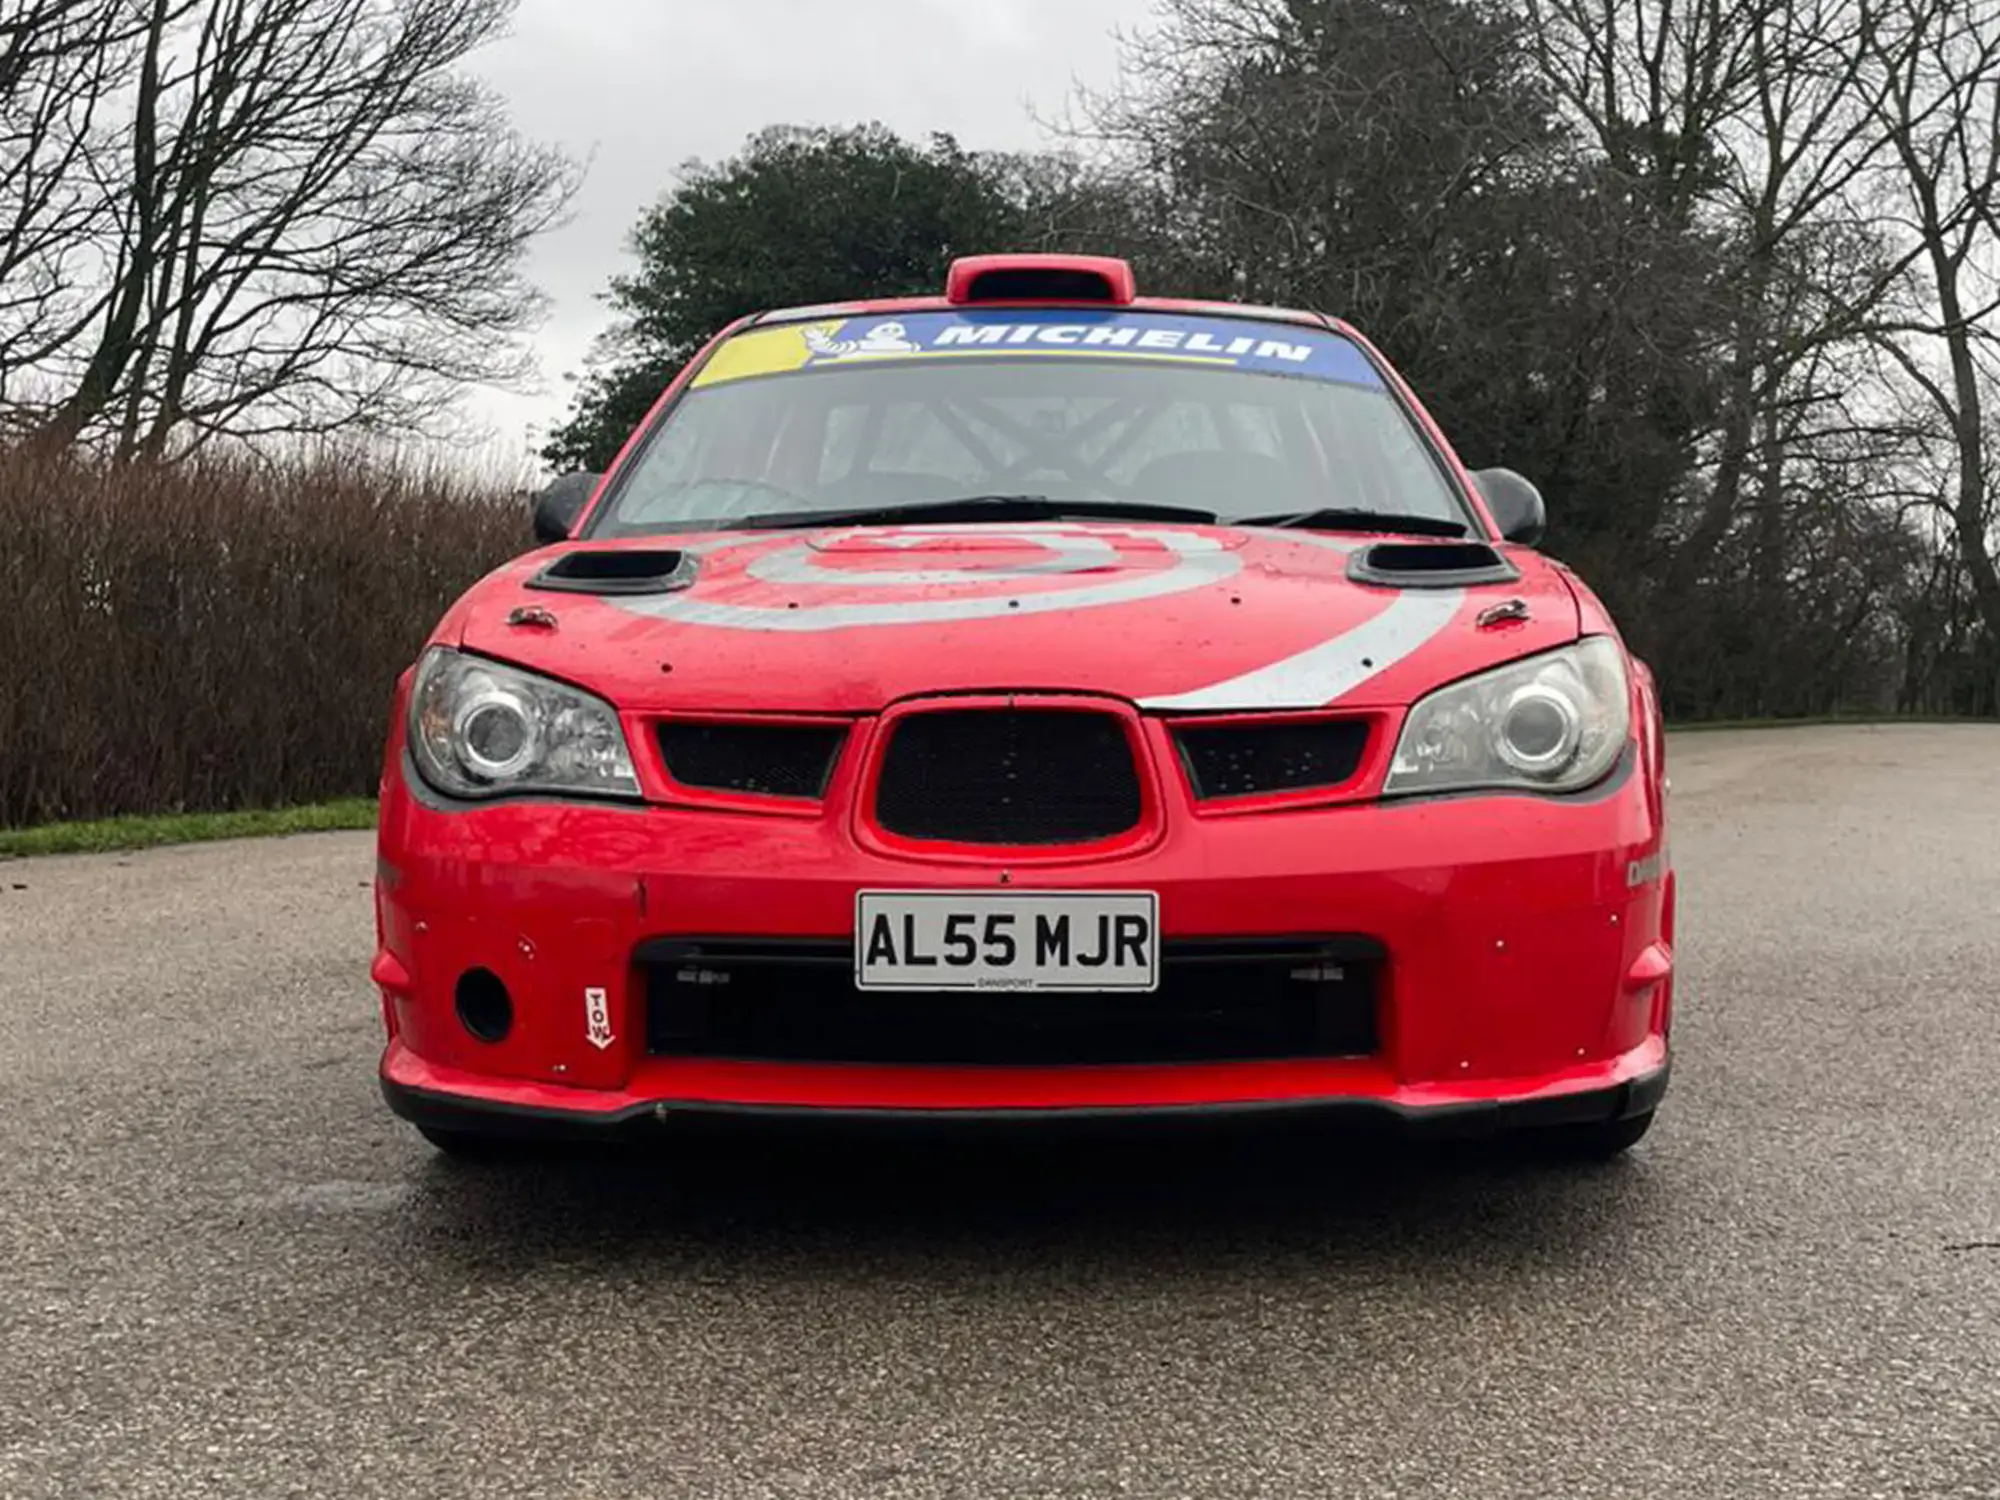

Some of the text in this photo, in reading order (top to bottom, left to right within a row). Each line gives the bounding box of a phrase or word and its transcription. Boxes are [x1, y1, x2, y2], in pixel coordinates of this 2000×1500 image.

[934, 325, 1312, 361] MICHELIN
[866, 913, 1149, 967] AL55 MJR
[589, 993, 608, 1038] TOW
